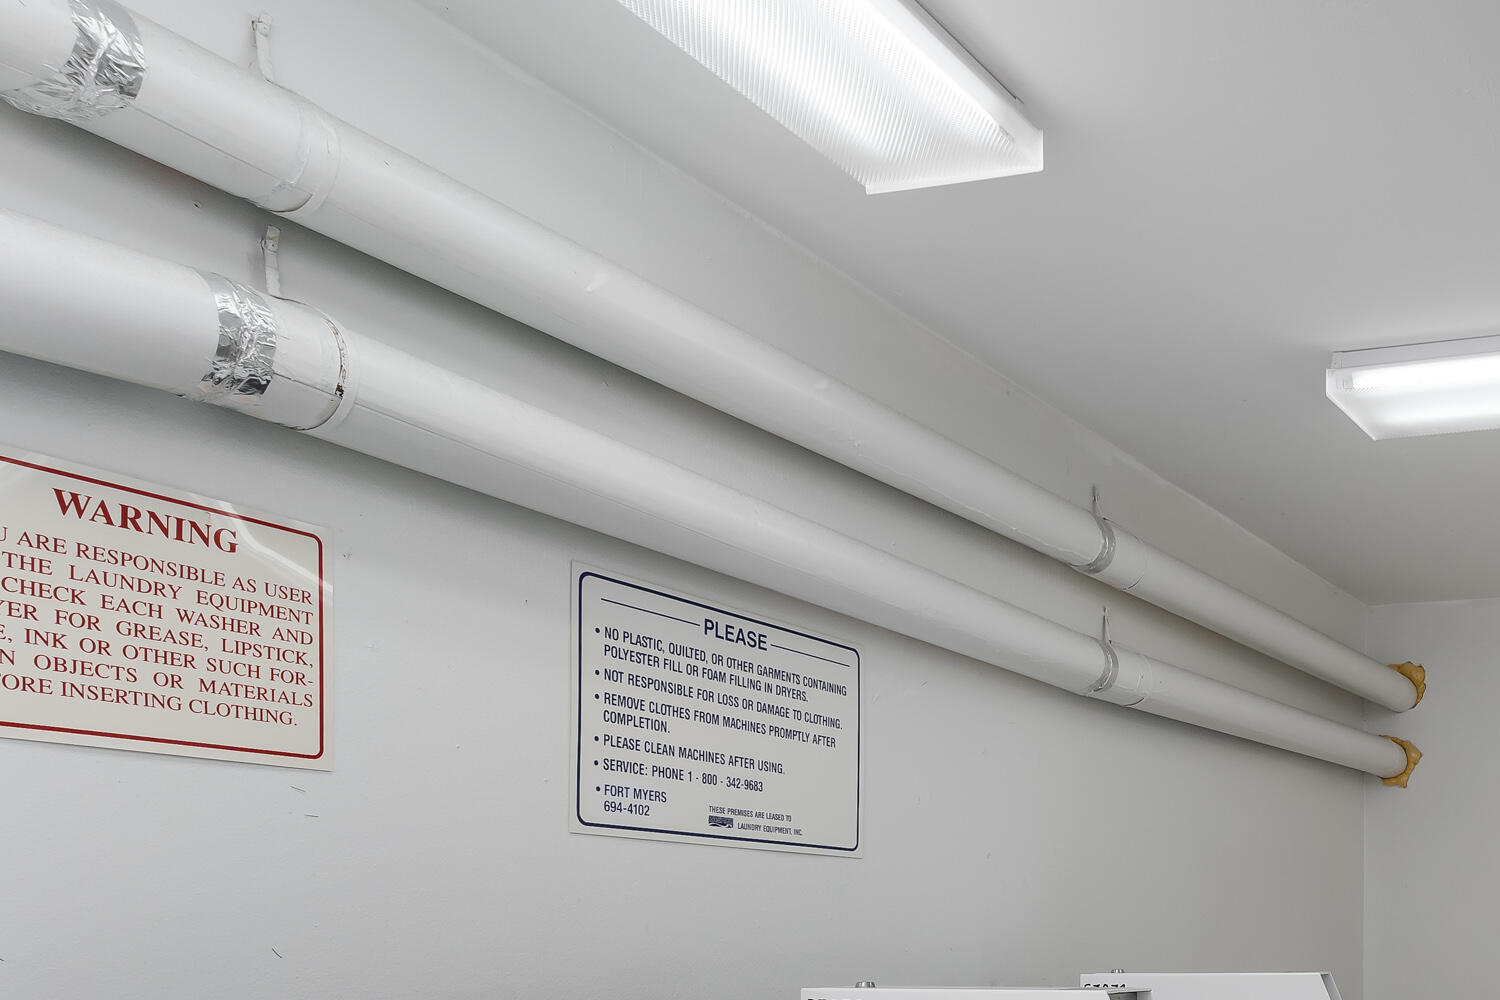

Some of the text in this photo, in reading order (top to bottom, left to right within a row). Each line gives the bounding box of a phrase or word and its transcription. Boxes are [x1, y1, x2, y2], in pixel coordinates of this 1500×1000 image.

[52, 488, 239, 553] WARNING
[2, 551, 313, 626] THE LAUNDRY EQUIPMENT
[16, 531, 67, 554] ARE
[75, 541, 226, 587] RESPONSIBLE
[232, 577, 256, 593] AS
[264, 582, 314, 606] USER
[1, 577, 313, 647] CHECK EACH WASHER AND
[54, 607, 102, 632] FOR
[116, 620, 209, 652] GREASE,
[221, 637, 314, 668] LIPSTICK,
[704, 618, 768, 651] PLEASE
[24, 628, 69, 650] INK
[79, 638, 112, 656] OR
[120, 643, 198, 671] OTHER
[205, 657, 263, 679] SUCH
[269, 664, 314, 686] FOR-
[34, 654, 138, 685] OBJECTS
[153, 672, 184, 689] OR
[199, 677, 313, 708] MATERIALS
[604, 626, 847, 697] NO PLASTIC, QUILTED, OR OTHER GARMENTS CONTAINING
[604, 644, 809, 702] POLYESTER FILL OR FOAM FILLING IN DRYERS.
[0, 673, 297, 726] ORE INSERTING CLOTHING.
[603, 710, 671, 733] COMPLETION.
[604, 669, 843, 730] NOT RESPONSIBLE FOR LOSS OR DAMAGE TO CLOTHING.
[604, 692, 836, 748] REMOVE CLOTHES FROM MACHINES PROMPTLY AFTER
[603, 734, 786, 774] PLEASE CLEAN MACHINES AFTER USING.
[603, 759, 648, 776] SERVICE:
[652, 766, 684, 781] PHONE
[687, 771, 692, 782] 1
[702, 772, 718, 786] 800
[726, 776, 764, 792] 342-9683
[604, 784, 668, 802] FORT MYERS
[604, 801, 650, 816] 694-4102
[709, 805, 726, 814] THESE
[727, 807, 753, 818] PREMISES
[755, 811, 765, 819] ARE
[766, 812, 785, 821] LEASED
[738, 822, 762, 832] LAUNDRY
